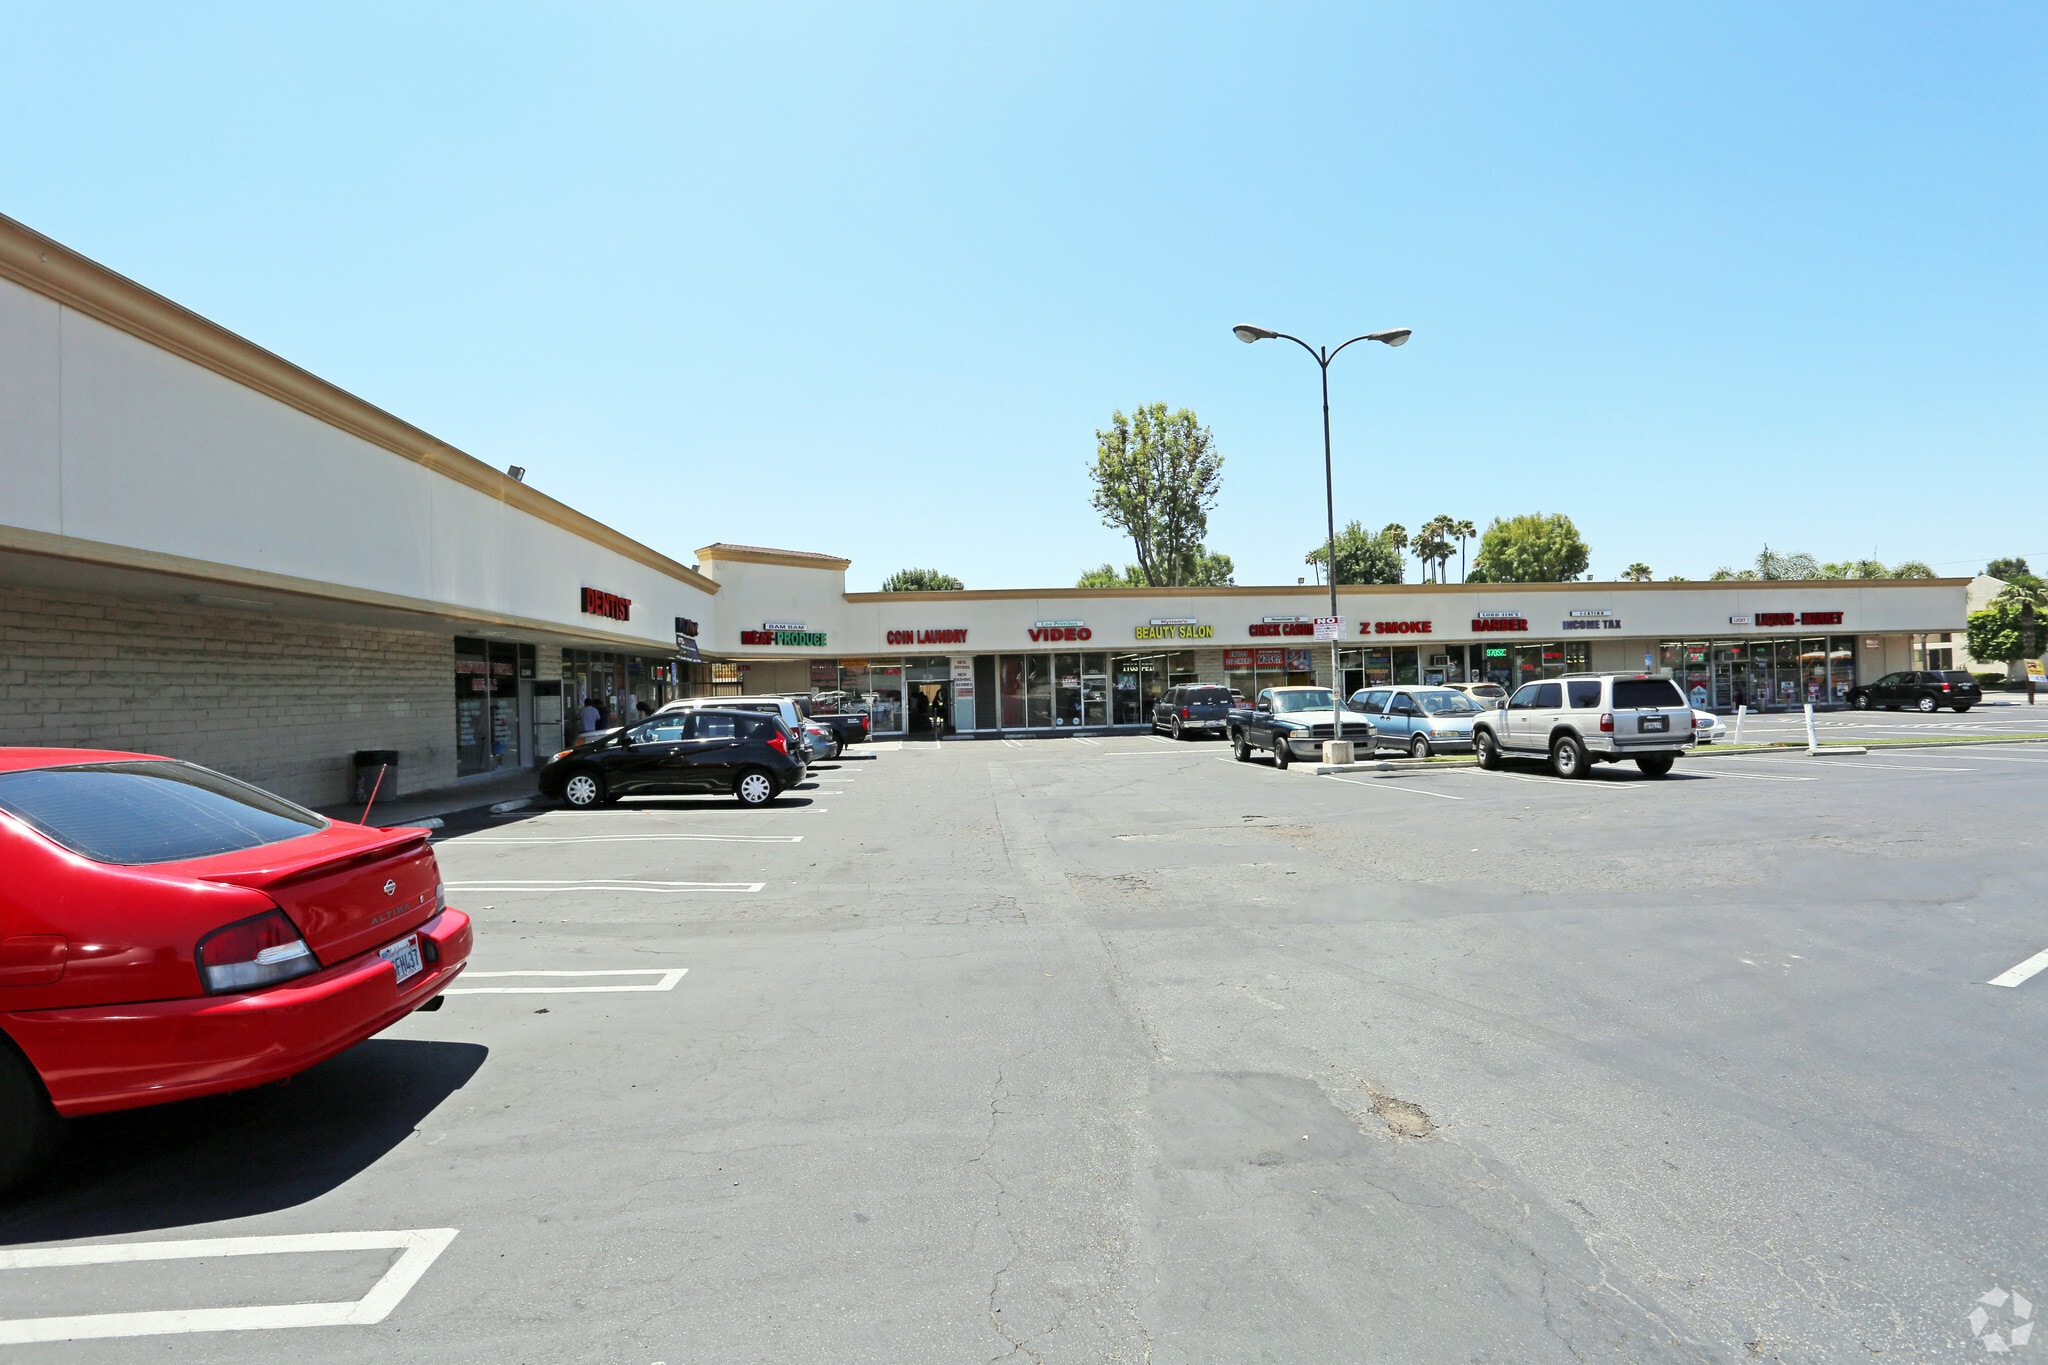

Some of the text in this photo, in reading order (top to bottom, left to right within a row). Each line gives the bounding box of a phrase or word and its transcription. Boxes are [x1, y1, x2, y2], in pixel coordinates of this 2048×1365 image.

[586, 587, 632, 621] DENTIST
[1472, 619, 1529, 632] BARBER
[1562, 619, 1622, 630] INCOME TAX
[1755, 613, 1795, 627] LIQUOR
[1801, 612, 1844, 625] MARKET
[1028, 627, 1092, 642] VIDEO
[1136, 625, 1213, 640] BEAUTY SALON
[1249, 624, 1282, 637] CHECK
[1359, 622, 1371, 634] Z
[1375, 621, 1432, 634] SMOKE
[887, 628, 968, 645] COIN LAUNDRY
[371, 903, 410, 926] ALTIMA
